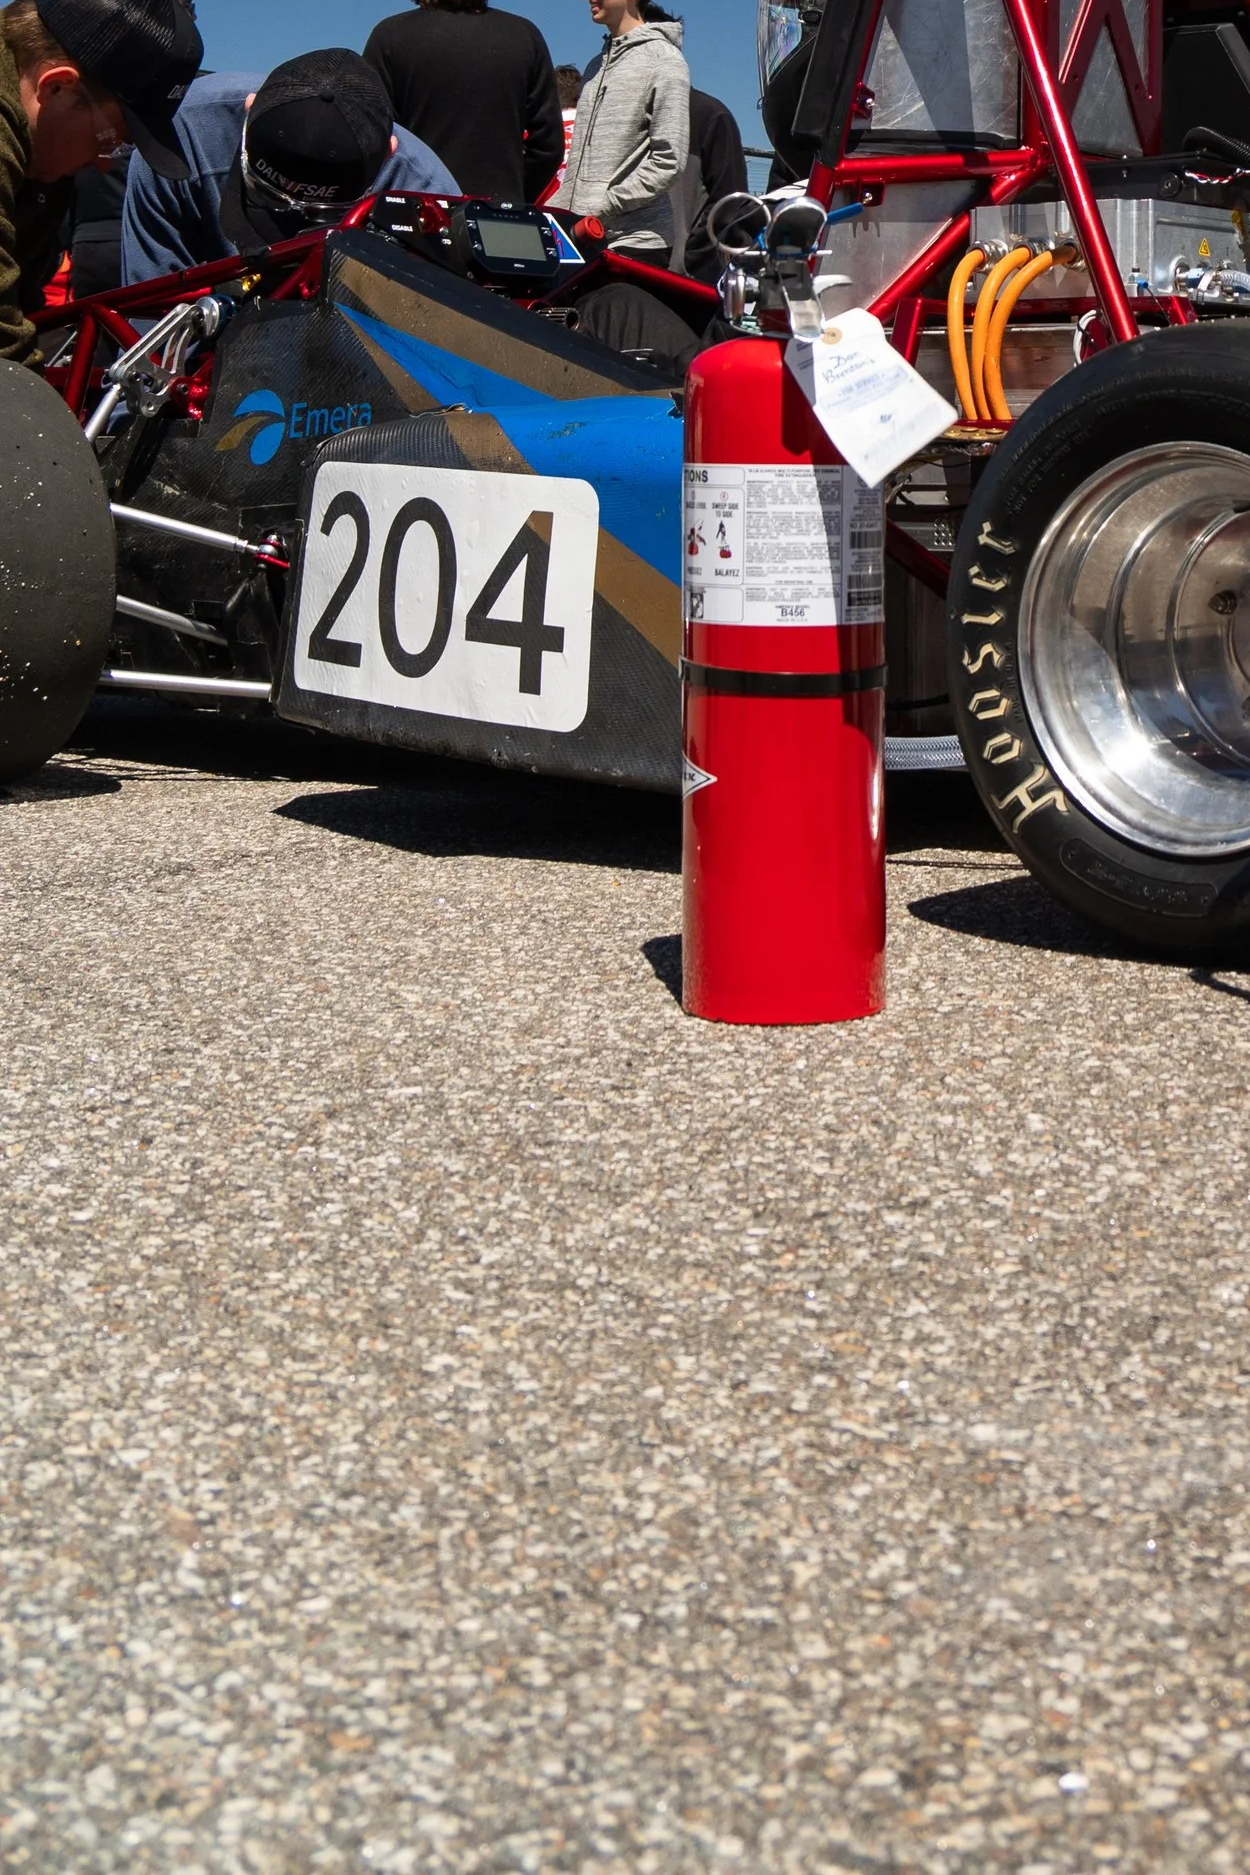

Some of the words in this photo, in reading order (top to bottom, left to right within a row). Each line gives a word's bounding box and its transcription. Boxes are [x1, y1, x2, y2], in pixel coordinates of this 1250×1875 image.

[289, 402, 372, 438] Emera
[714, 568, 740, 577] BALAYEZ
[307, 490, 565, 696] 204
[781, 608, 805, 617] B456
[960, 519, 1070, 834] Hoosier
